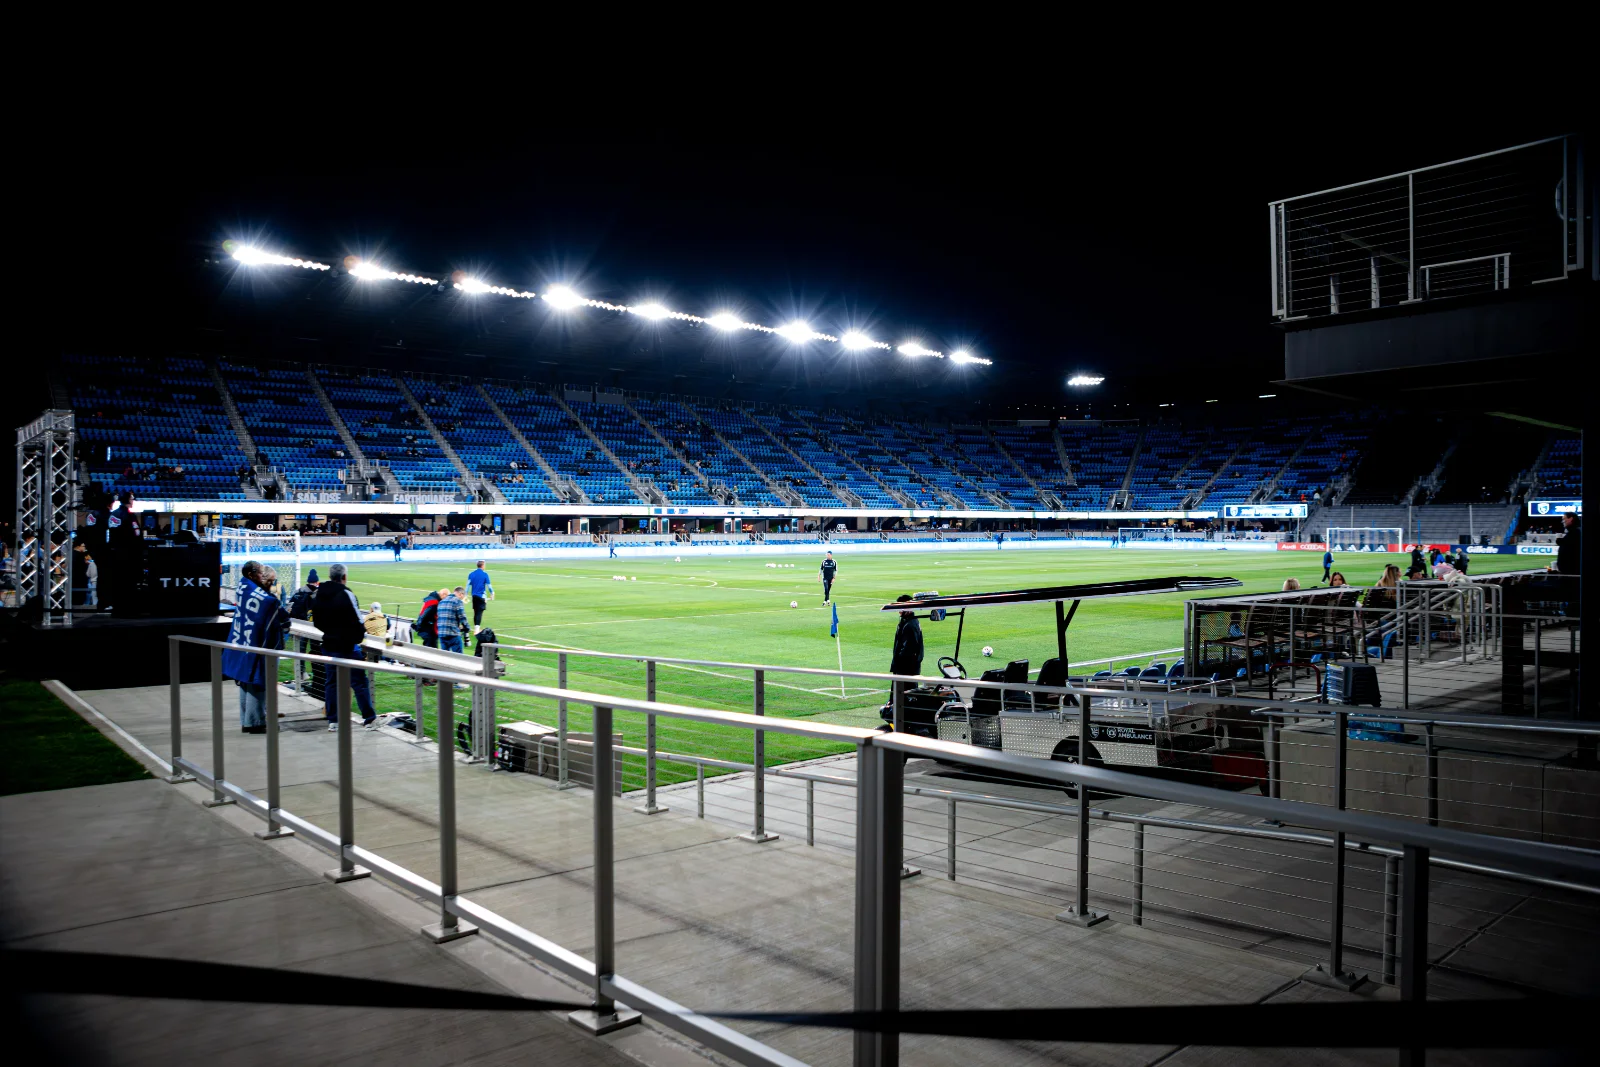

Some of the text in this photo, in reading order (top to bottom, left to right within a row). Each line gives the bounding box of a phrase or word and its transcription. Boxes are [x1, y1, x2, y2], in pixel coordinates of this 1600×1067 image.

[296, 492, 341, 503] SAN JOSE
[393, 494, 455, 504] EARTHQUAKES
[1466, 545, 1499, 554] Gillette
[1521, 546, 1553, 554] CEFCU
[159, 577, 211, 588] TIXR
